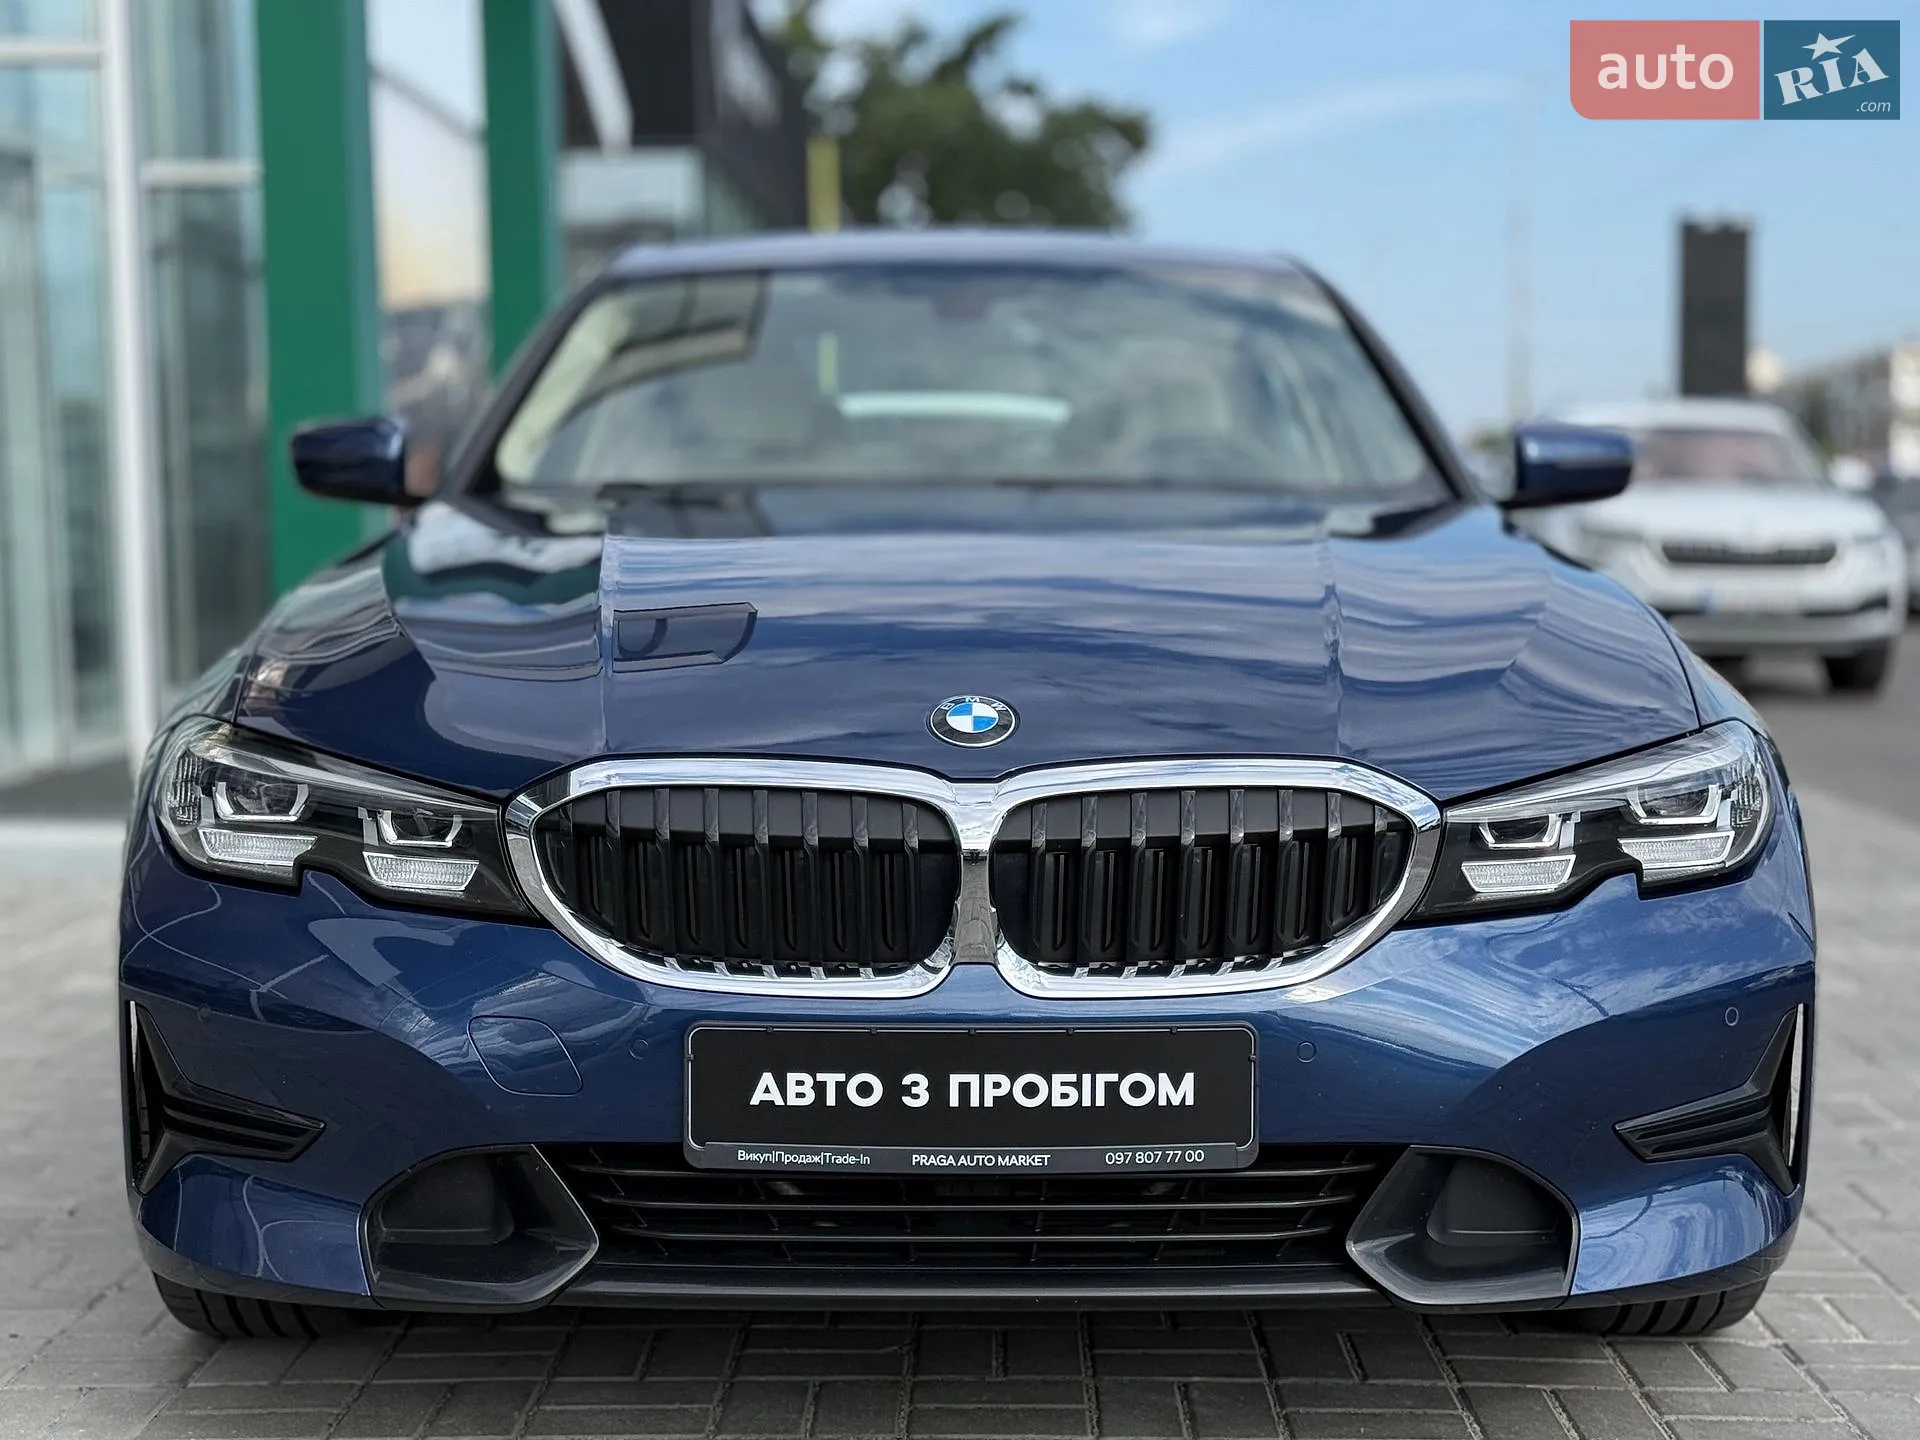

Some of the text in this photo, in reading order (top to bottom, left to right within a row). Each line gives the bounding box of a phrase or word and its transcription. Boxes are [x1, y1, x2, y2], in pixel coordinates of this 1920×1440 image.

[940, 697, 1006, 711] BMW
[750, 1072, 884, 1107] АВТО
[949, 1072, 1195, 1107] ПРОБІГОМ
[912, 1155, 1051, 1166] PRAGA AUTO MARKET
[1105, 1150, 1205, 1165] 097 807 77 00
